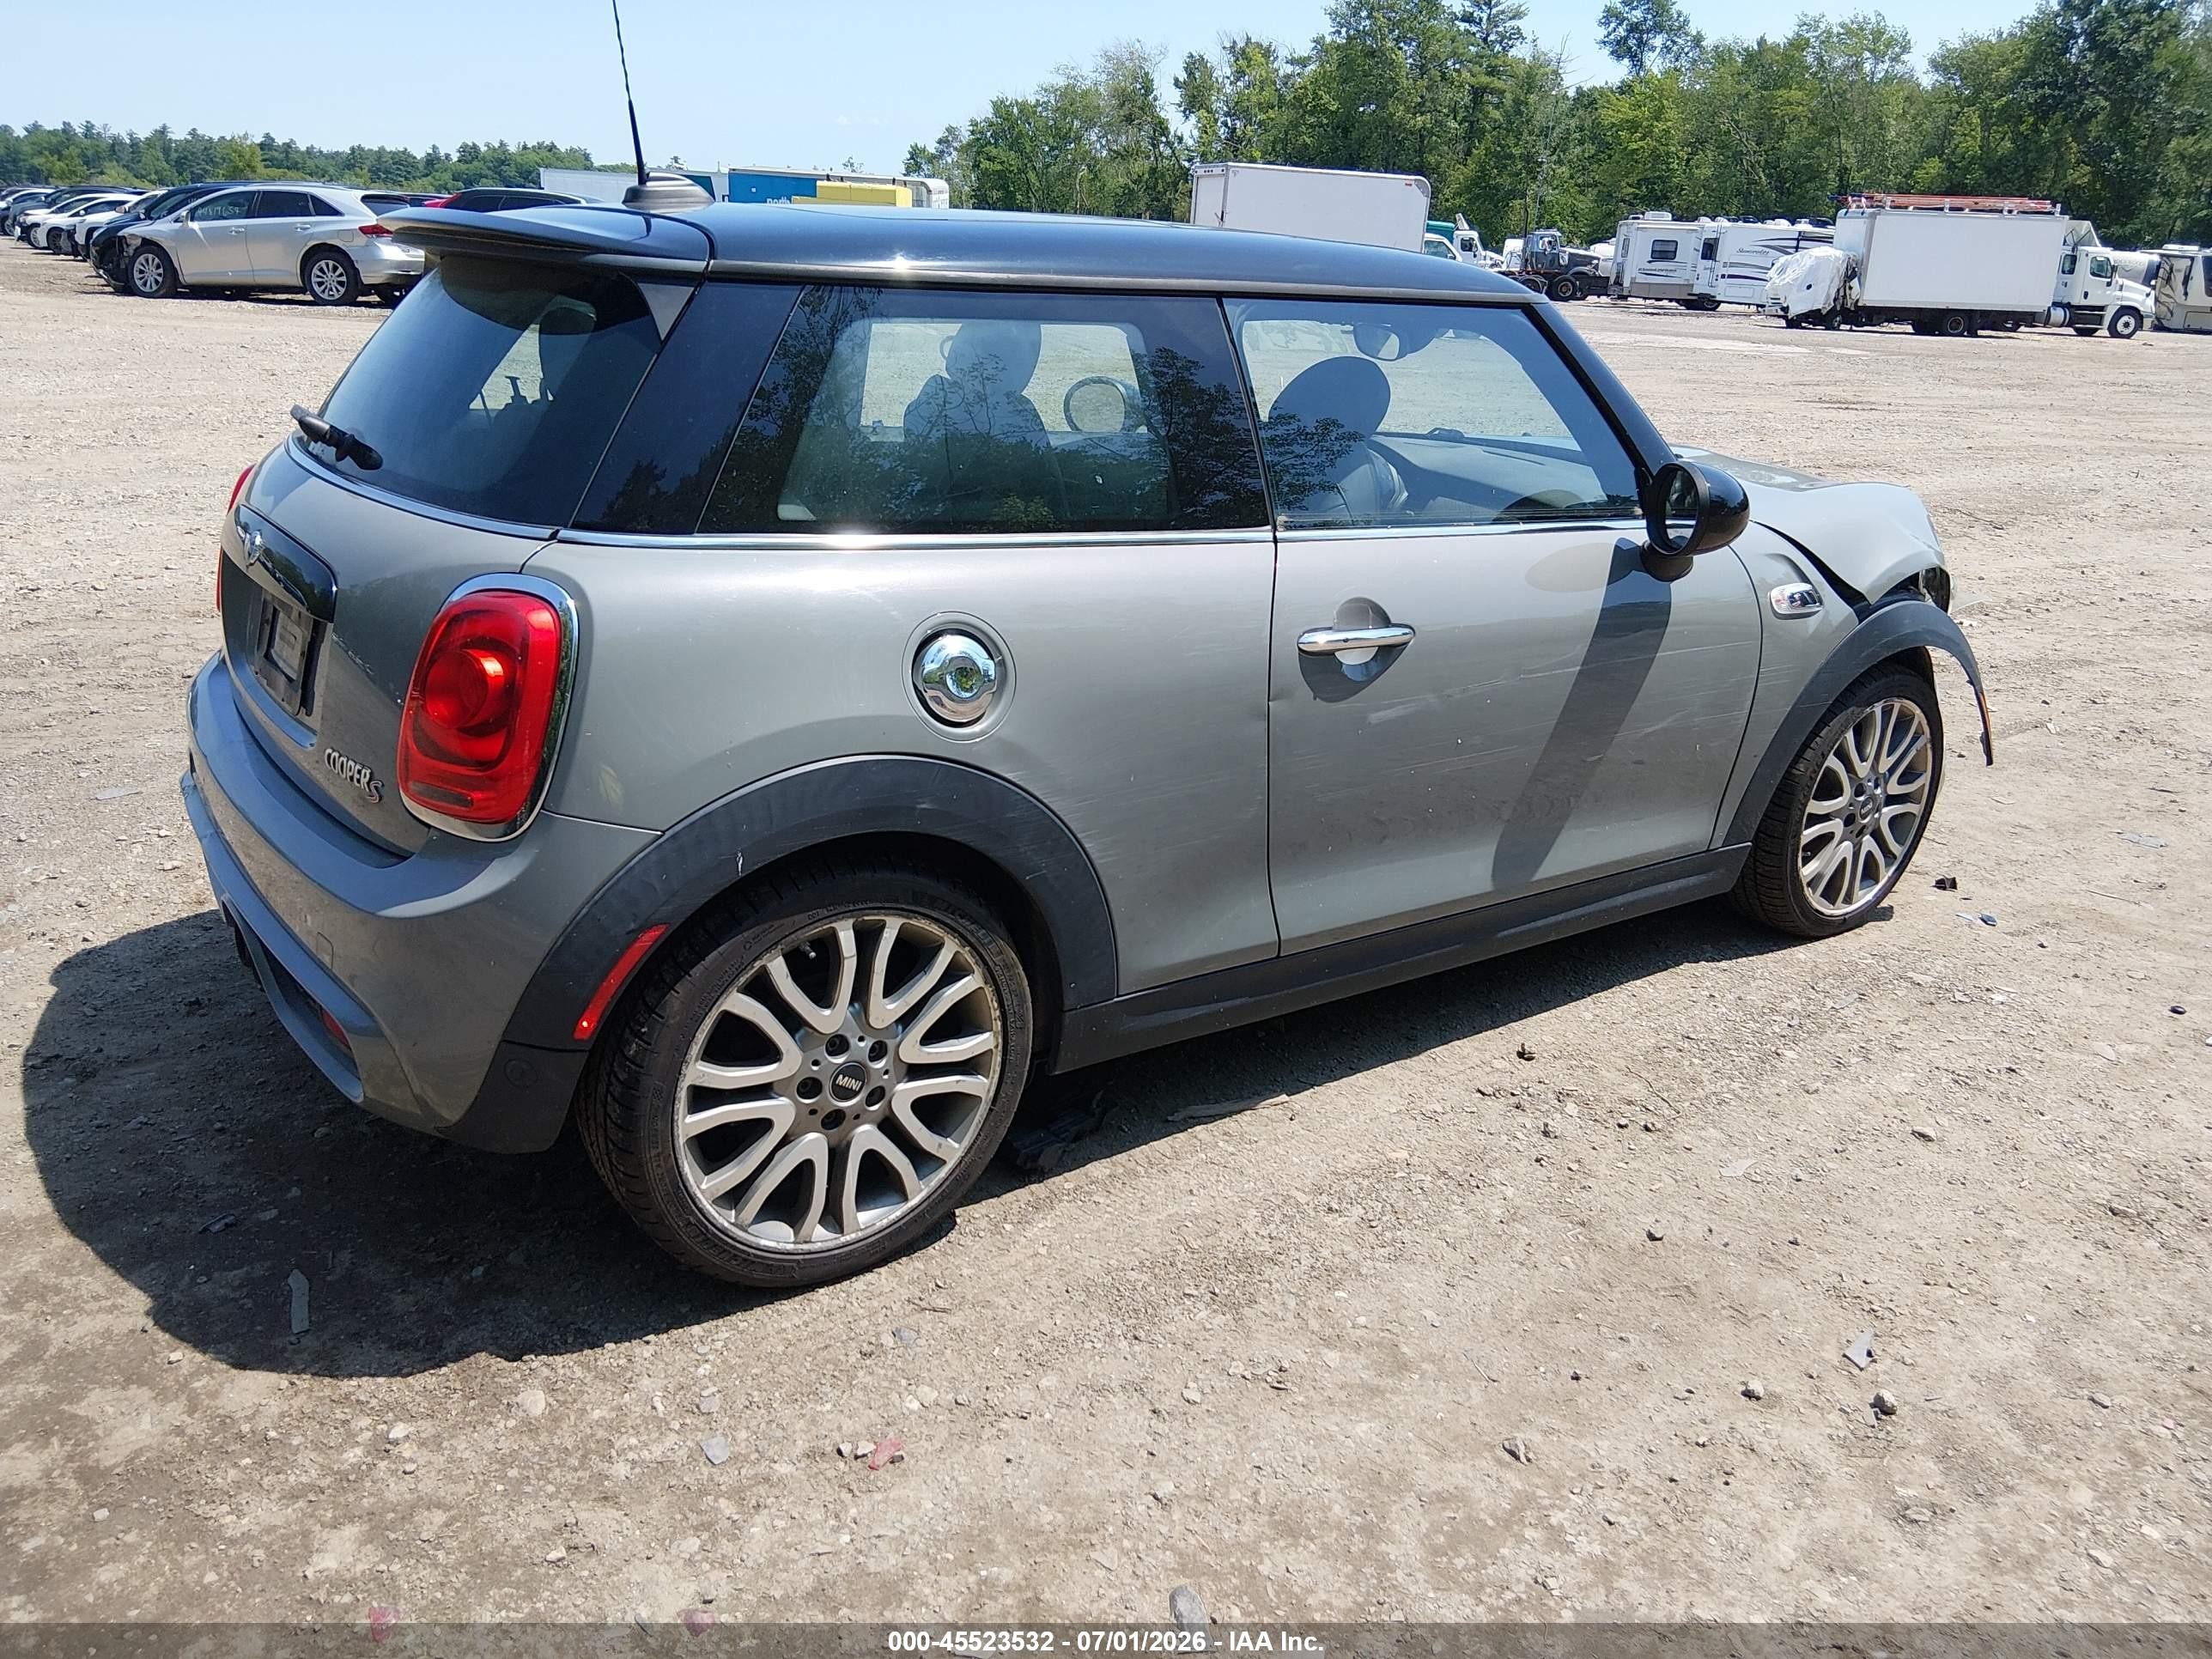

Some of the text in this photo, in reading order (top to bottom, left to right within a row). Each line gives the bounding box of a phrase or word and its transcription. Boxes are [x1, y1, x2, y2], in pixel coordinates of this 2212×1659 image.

[325, 748, 383, 805] COOPER S
[836, 1073, 862, 1091] MINI
